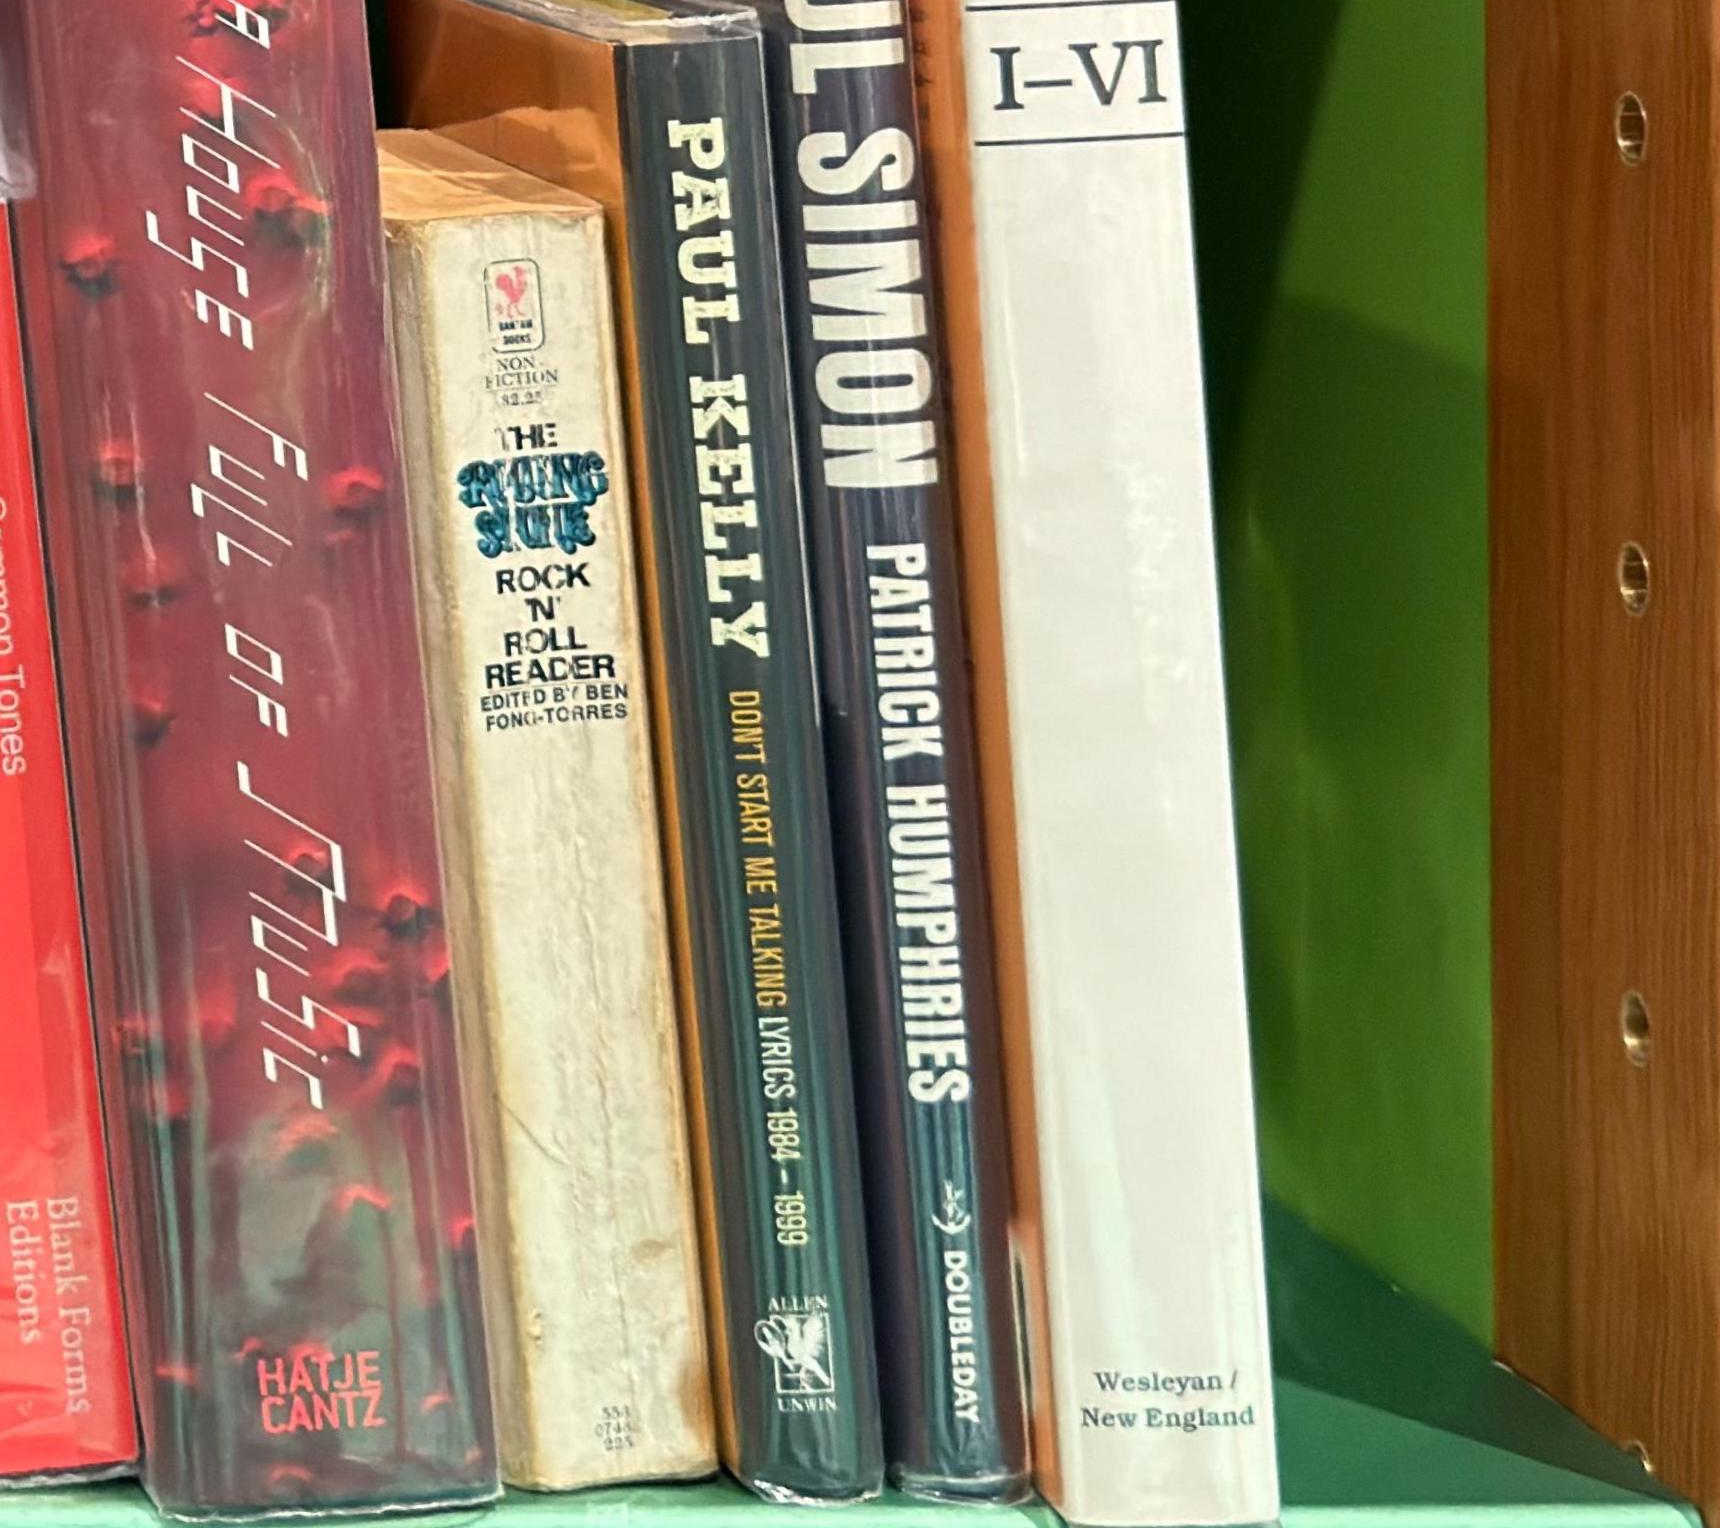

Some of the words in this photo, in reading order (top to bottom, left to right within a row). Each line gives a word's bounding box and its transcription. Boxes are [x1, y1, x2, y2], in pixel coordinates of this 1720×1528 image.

[668, 117, 739, 344] PAUL
[795, 127, 940, 490] SIMON
[690, 373, 770, 660] KELLY
[496, 562, 590, 594] ROCK
[485, 654, 615, 690] READER
[504, 626, 587, 658] ROLL
[866, 542, 944, 756] PATRICK
[730, 689, 766, 768] DON'T
[737, 772, 774, 848] START
[743, 857, 778, 895] ME
[748, 902, 789, 1009] TALKING
[879, 783, 970, 1106] HUMPHRIES
[758, 1016, 797, 1099] LYRICS
[767, 1104, 801, 1160] 1984
[47, 1196, 88, 1296] Blank
[773, 1192, 810, 1246] 1999
[6, 1200, 46, 1345] Editions
[769, 1295, 830, 1311] ALLEN
[60, 1307, 91, 1415] Forms
[257, 1351, 381, 1394] HATJE
[944, 1248, 981, 1423] DOUBLEDAY
[262, 1388, 386, 1435] CANTZ
[777, 1397, 838, 1413] UNWIN
[1081, 1405, 1139, 1429] New
[1144, 1405, 1255, 1431] England
[1096, 1369, 1226, 1396] Wesleyan
